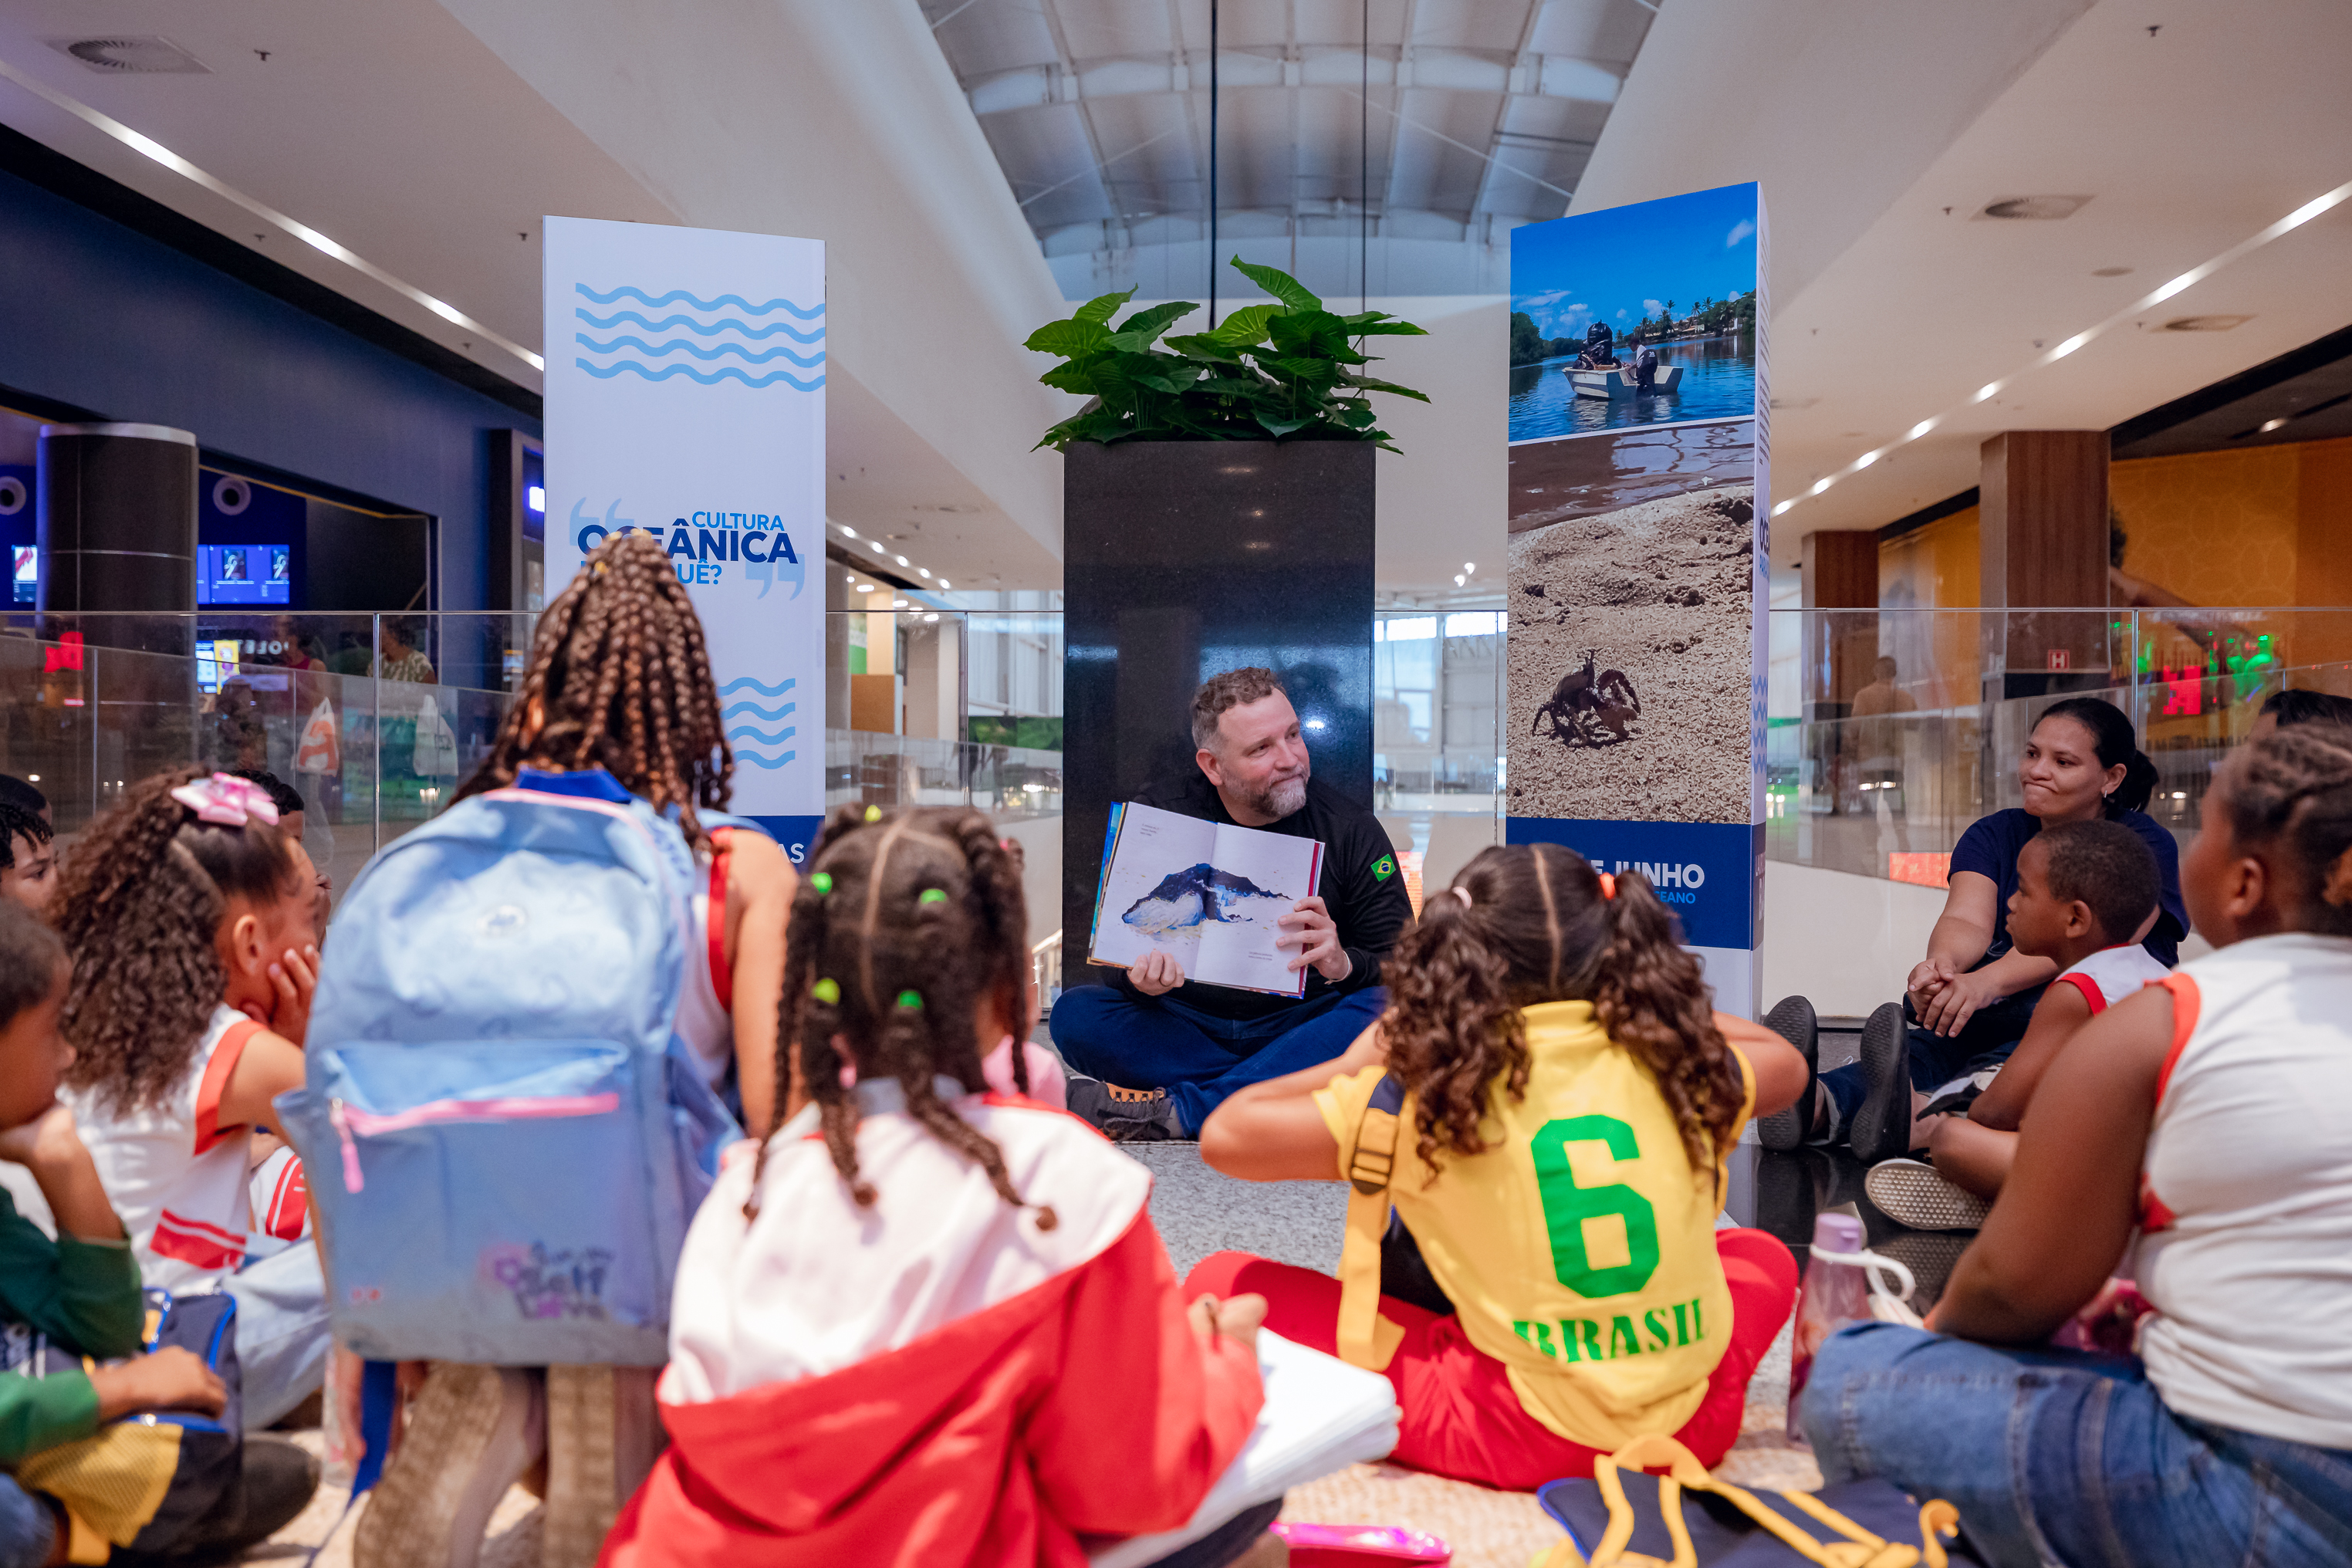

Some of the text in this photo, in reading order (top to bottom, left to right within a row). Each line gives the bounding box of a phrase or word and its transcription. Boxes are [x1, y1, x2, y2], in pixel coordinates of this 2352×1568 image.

[691, 511, 785, 531] CULTURA
[577, 518, 798, 564] OÂNICA
[674, 558, 722, 585] UÊ?
[1654, 890, 1696, 904] EANO
[1530, 1114, 1660, 1299] 6
[1512, 1298, 1705, 1364] BRASIL
